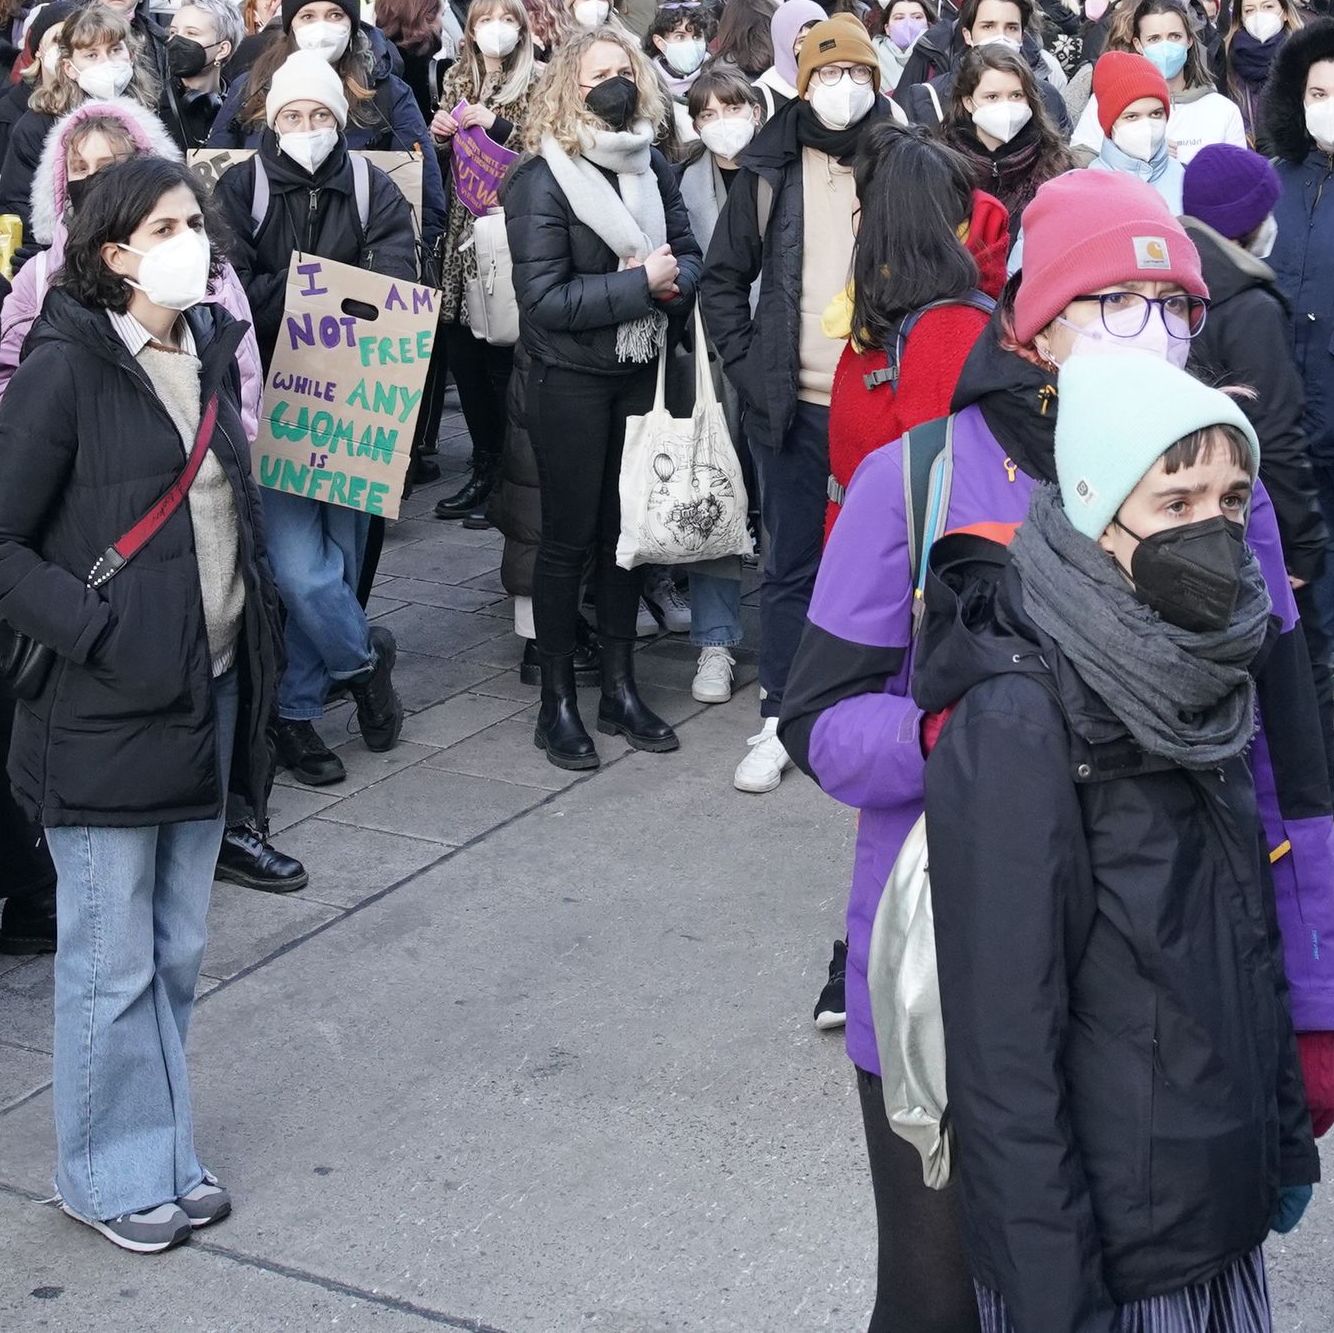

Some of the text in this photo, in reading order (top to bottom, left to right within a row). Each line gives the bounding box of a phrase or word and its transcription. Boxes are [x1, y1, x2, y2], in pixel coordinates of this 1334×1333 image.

[297, 262, 433, 315] I AM
[286, 313, 433, 367] NOT FREE
[272, 371, 423, 423] WHILE ANY
[270, 401, 399, 465] WOMAN
[260, 455, 390, 515] UNFREE
[310, 452, 328, 469] IS
